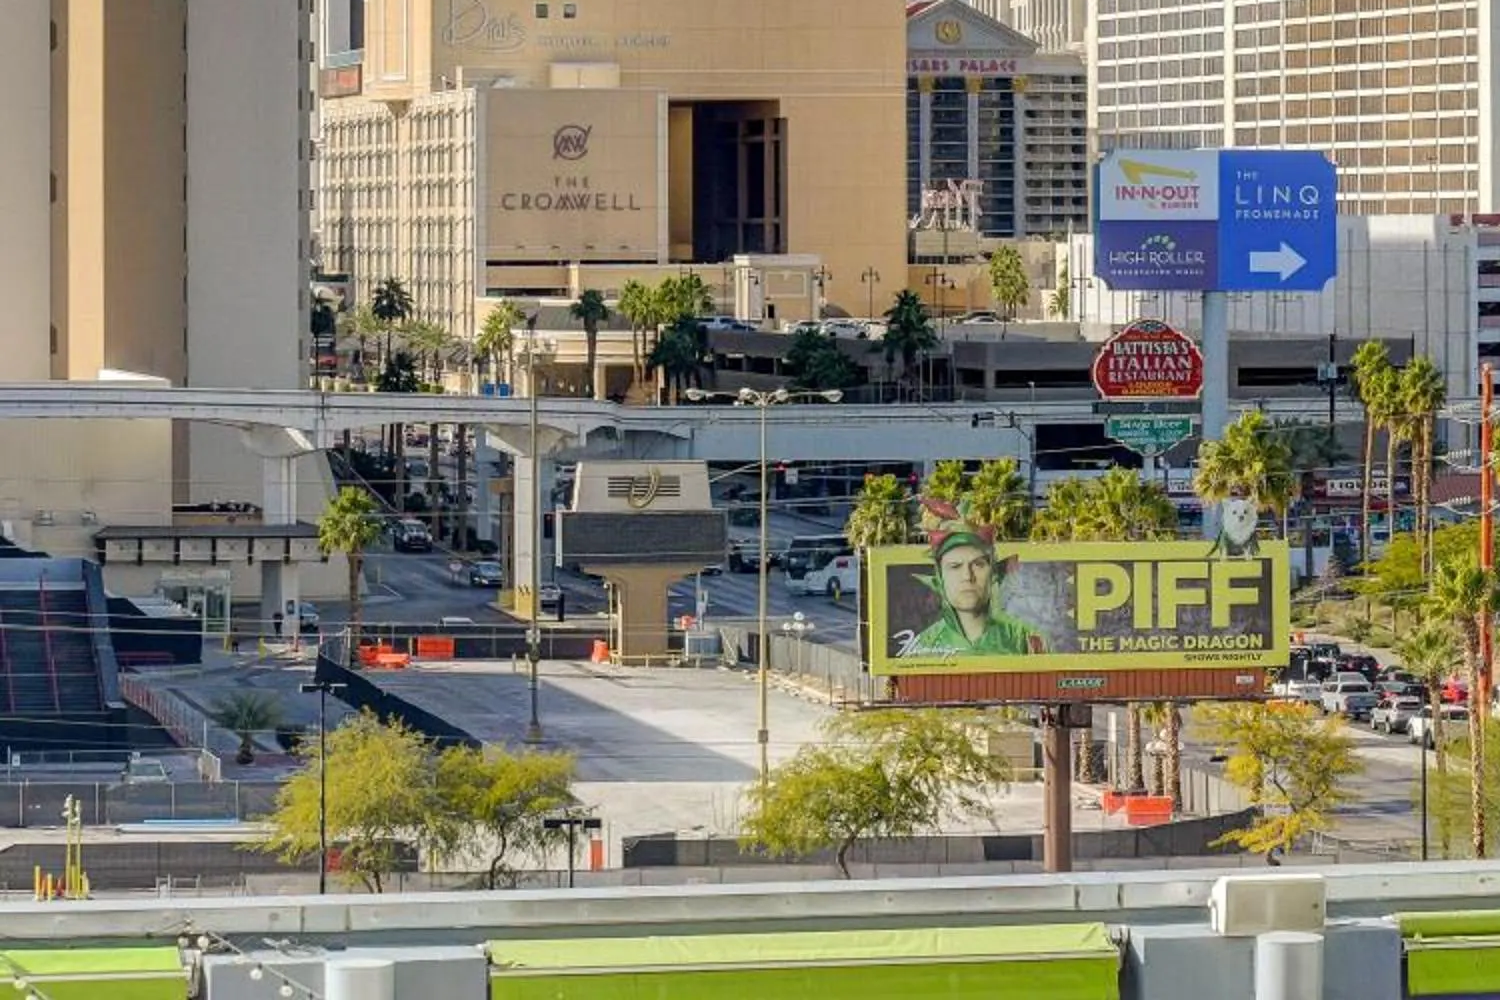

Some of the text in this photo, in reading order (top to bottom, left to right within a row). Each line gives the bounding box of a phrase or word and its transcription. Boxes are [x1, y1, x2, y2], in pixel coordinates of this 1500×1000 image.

[960, 60, 1017, 72] PALACE
[554, 176, 590, 188] THE
[1236, 170, 1258, 180] THE
[1235, 184, 1319, 205] LINQ
[501, 193, 641, 211] CROMWELL
[1235, 209, 1319, 220] PROMENADE
[1109, 251, 1205, 267] HIGH ROLLER
[1108, 355, 1192, 370] ITALIAN
[1108, 370, 1192, 383] RESTAURANT
[1076, 559, 1263, 631] PIFF
[1078, 633, 1263, 651] THE MAGIC DRAGON
[1184, 652, 1263, 661] SHOWS NIGHTLY
